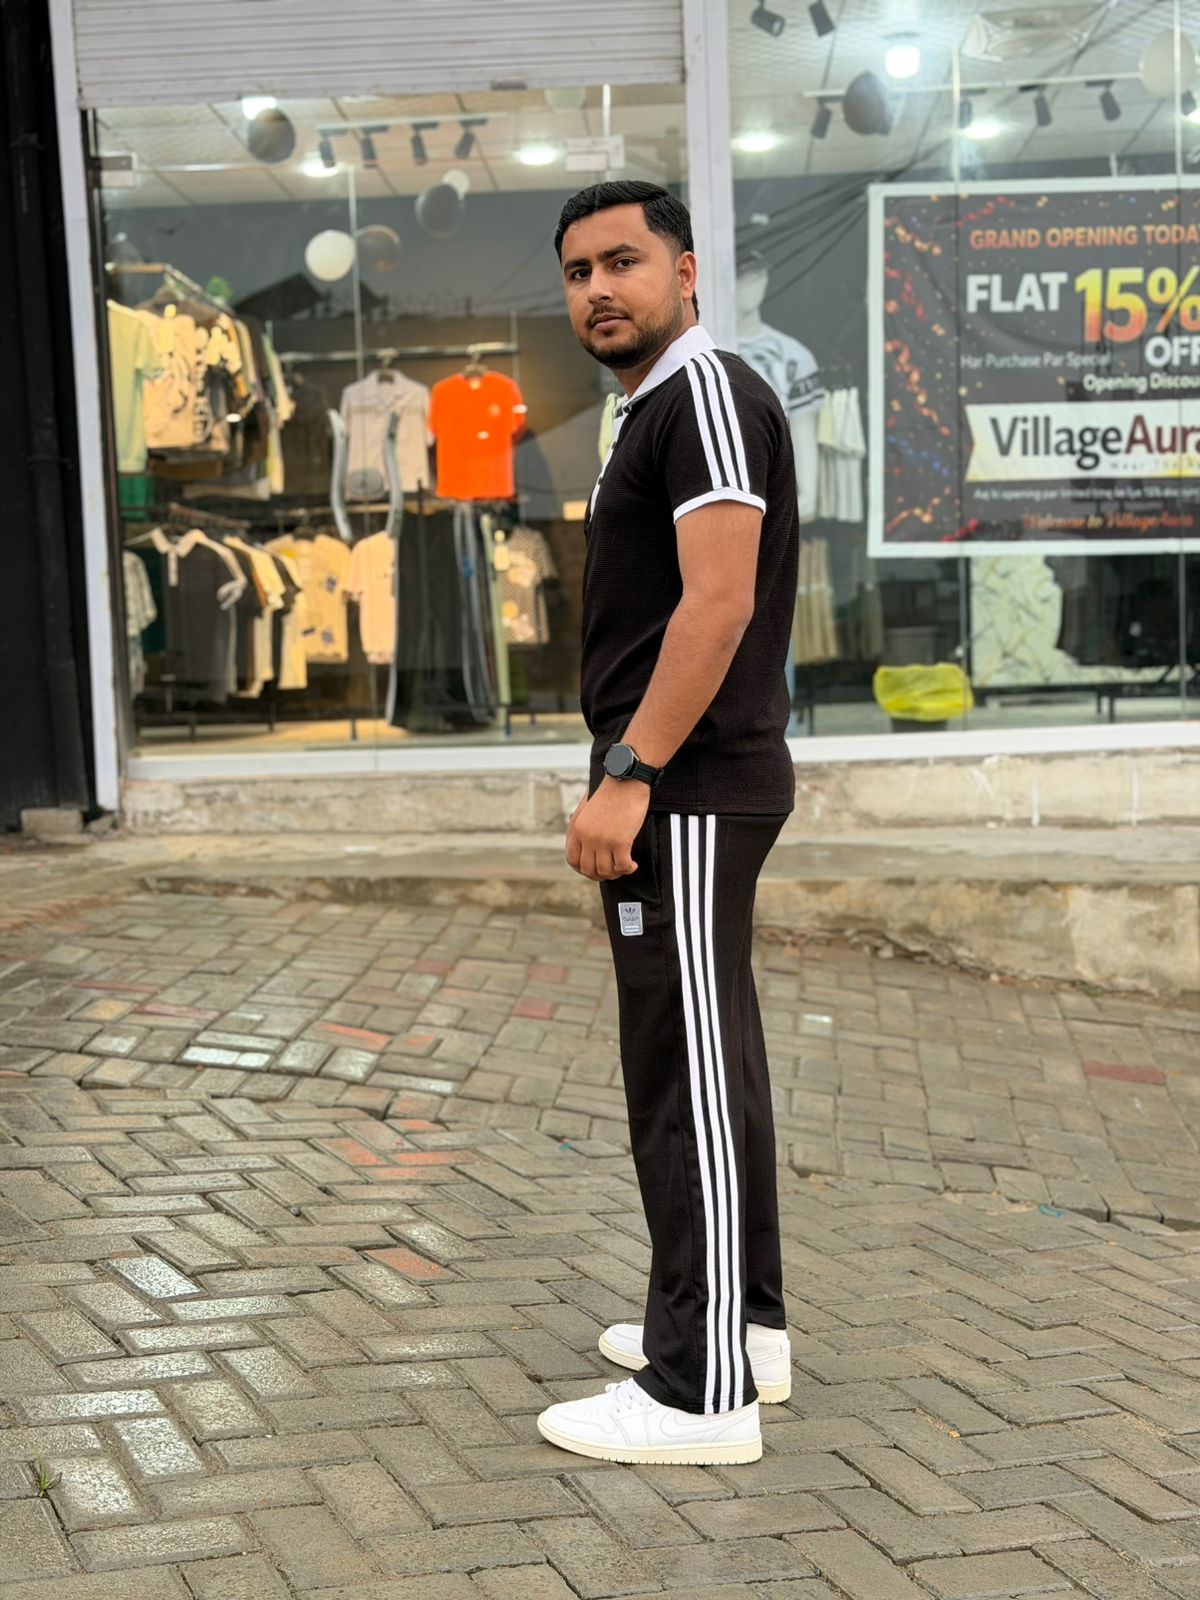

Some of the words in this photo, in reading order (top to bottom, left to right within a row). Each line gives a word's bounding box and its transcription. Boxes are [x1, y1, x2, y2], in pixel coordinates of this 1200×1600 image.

[970, 229, 1041, 249] GRAND
[1046, 226, 1138, 248] OPENING
[1142, 223, 1200, 246] TODA
[966, 272, 1068, 313] FLAT
[1074, 265, 1200, 343] 15%
[984, 352, 1041, 369] Purchase
[1066, 350, 1111, 370] Special
[1083, 374, 1148, 394] Opening
